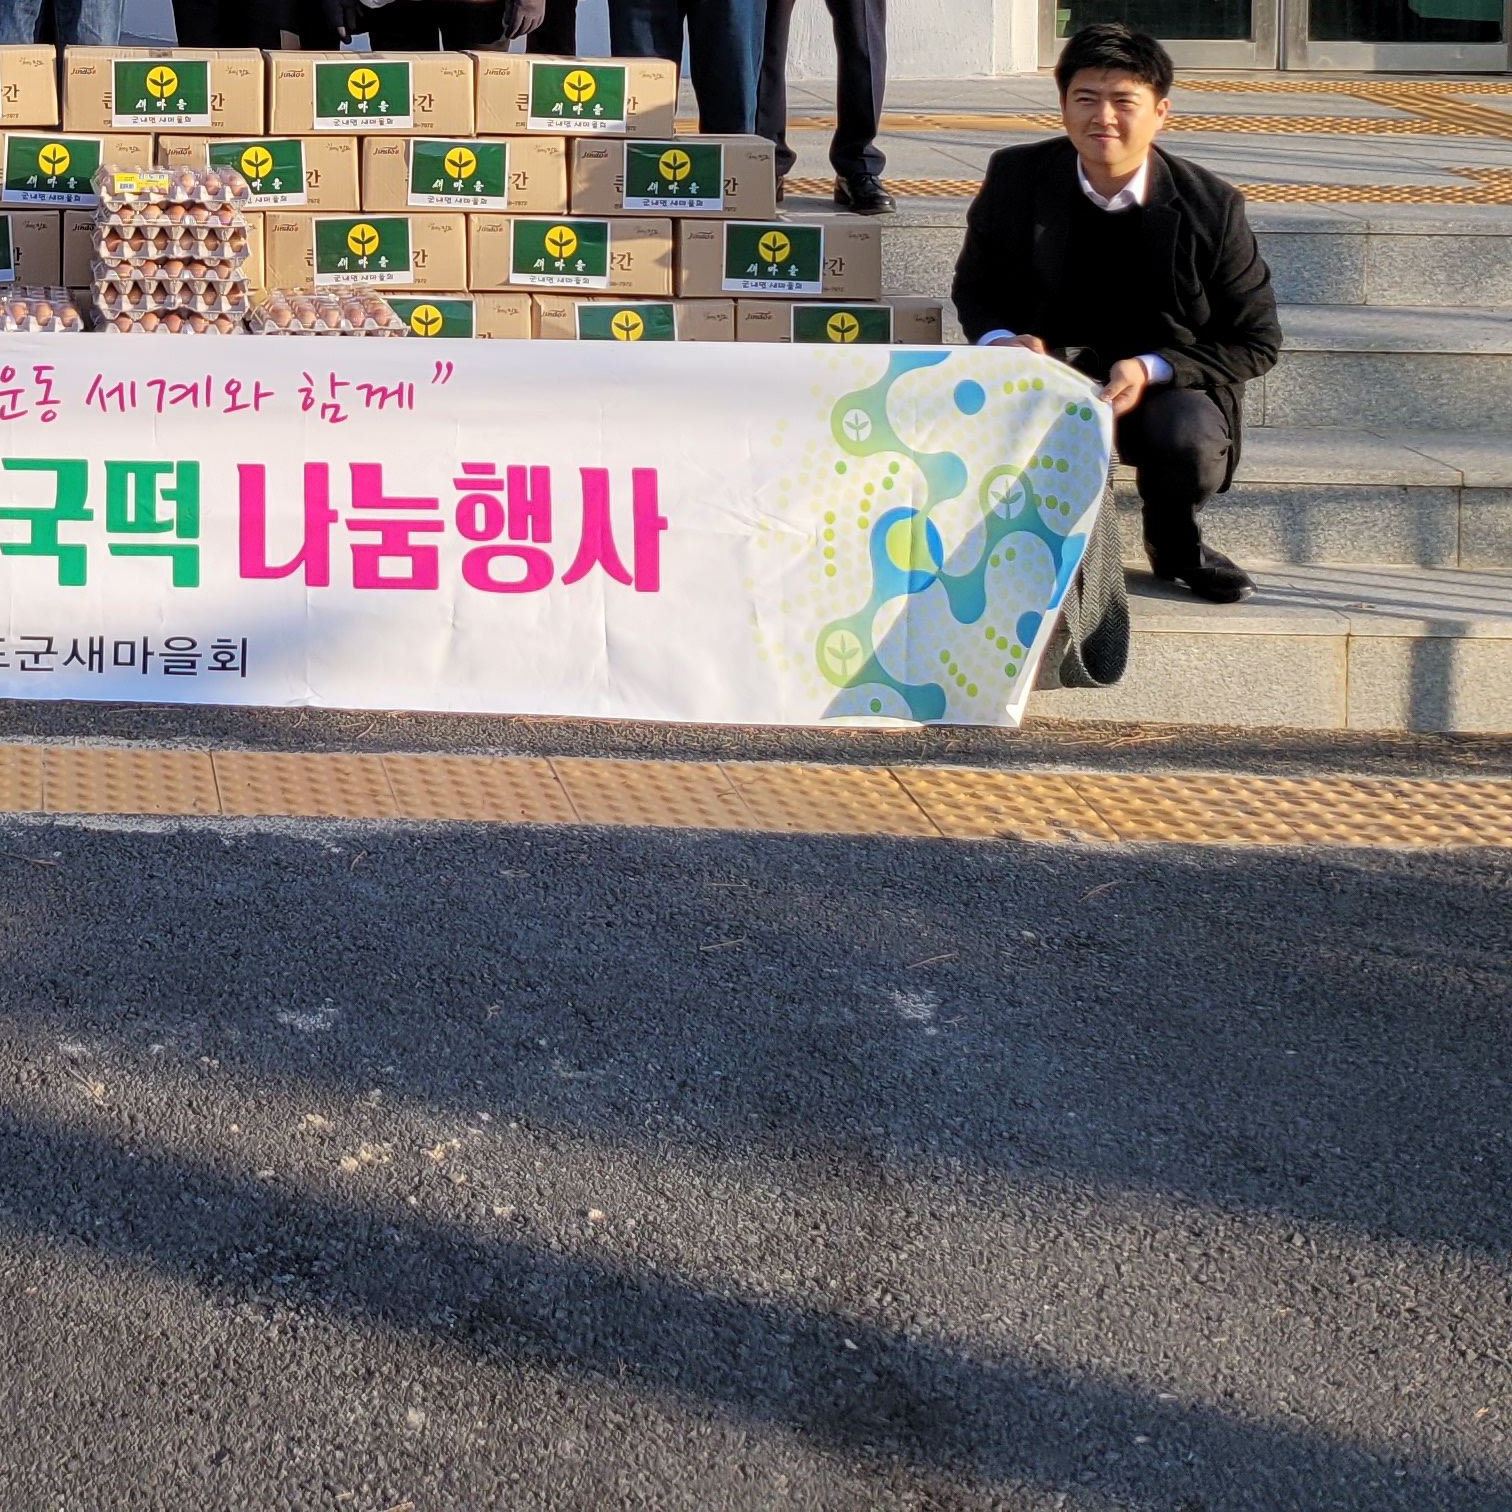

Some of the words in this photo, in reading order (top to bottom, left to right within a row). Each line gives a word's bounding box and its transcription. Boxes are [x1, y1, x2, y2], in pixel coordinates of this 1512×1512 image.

[86, 373, 275, 414] 세계와
[298, 371, 415, 424] 함께
[236, 461, 669, 595] 나눔행사
